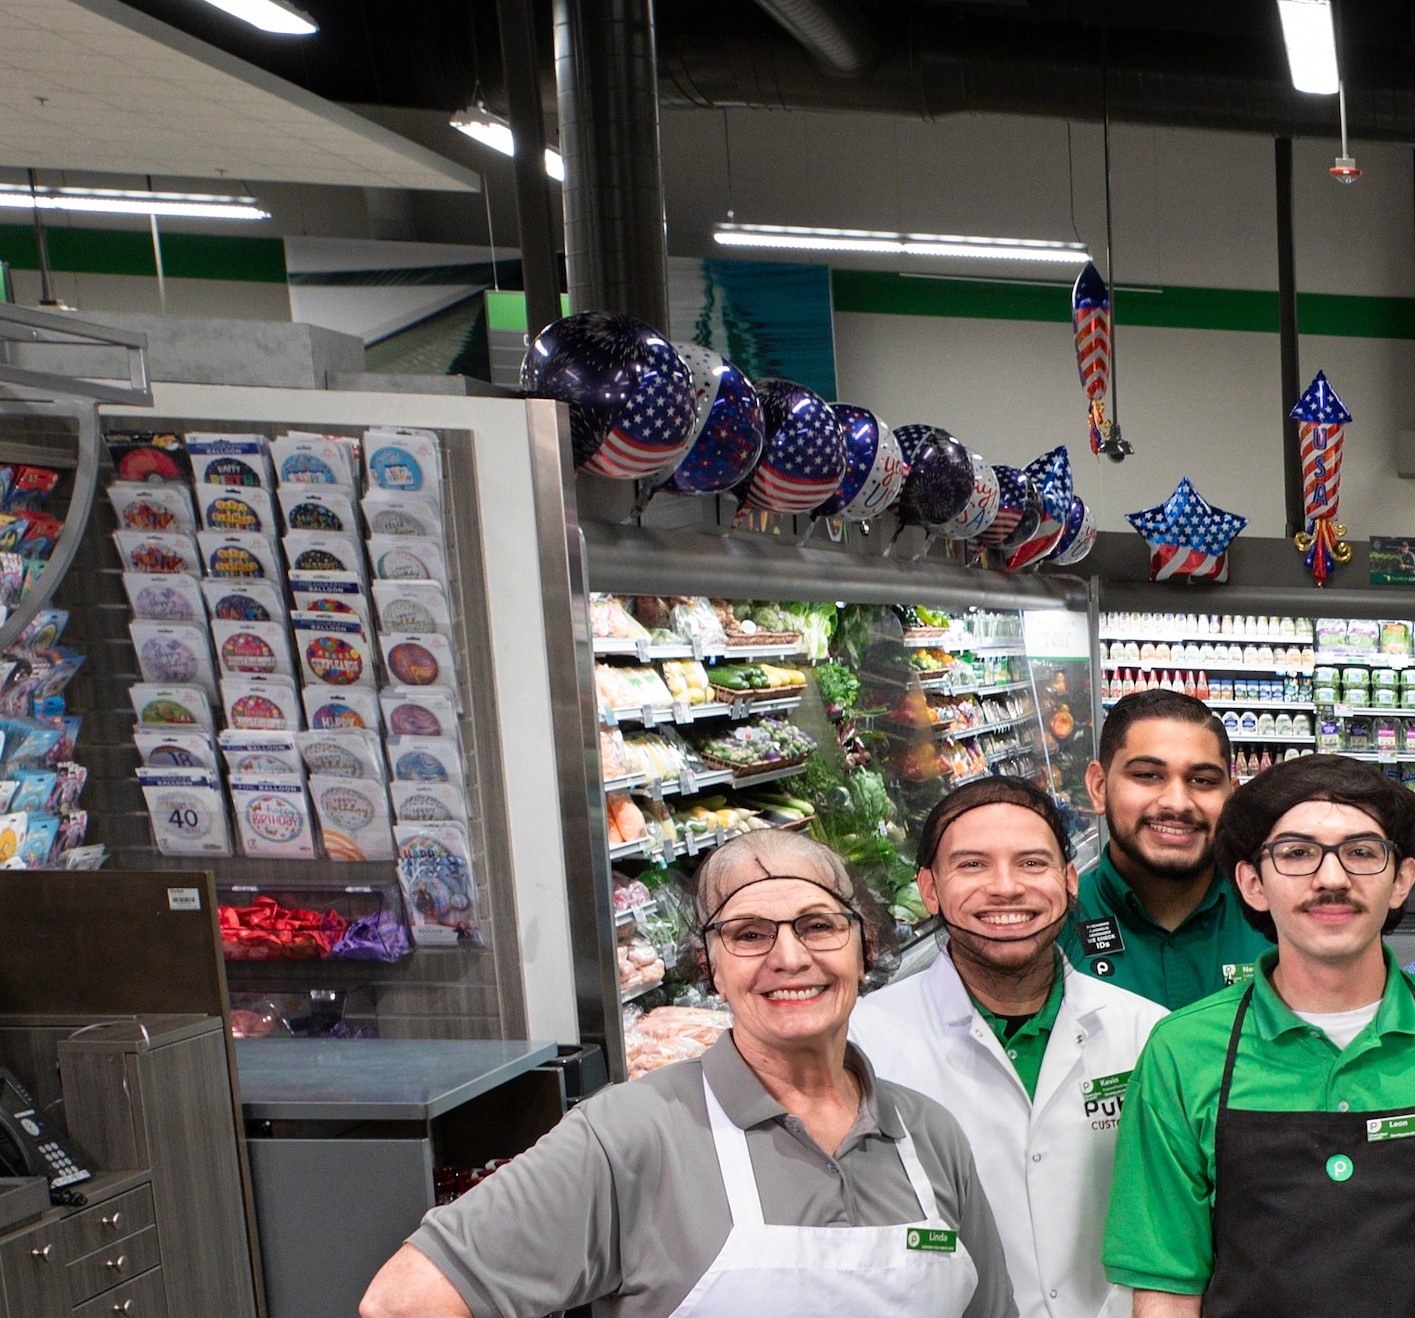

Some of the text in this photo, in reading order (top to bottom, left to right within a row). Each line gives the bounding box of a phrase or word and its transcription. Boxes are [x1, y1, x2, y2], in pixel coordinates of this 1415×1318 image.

[1312, 427, 1329, 508] USA
[308, 585, 344, 593] BALLOON
[311, 624, 347, 632] BALLOON
[258, 784, 298, 793] BALLOON
[168, 809, 199, 829] 40
[1097, 934, 1116, 942] CHECK
[1095, 941, 1111, 950] IDs
[1100, 1076, 1120, 1087] Kevin
[928, 1231, 948, 1242] Linda
